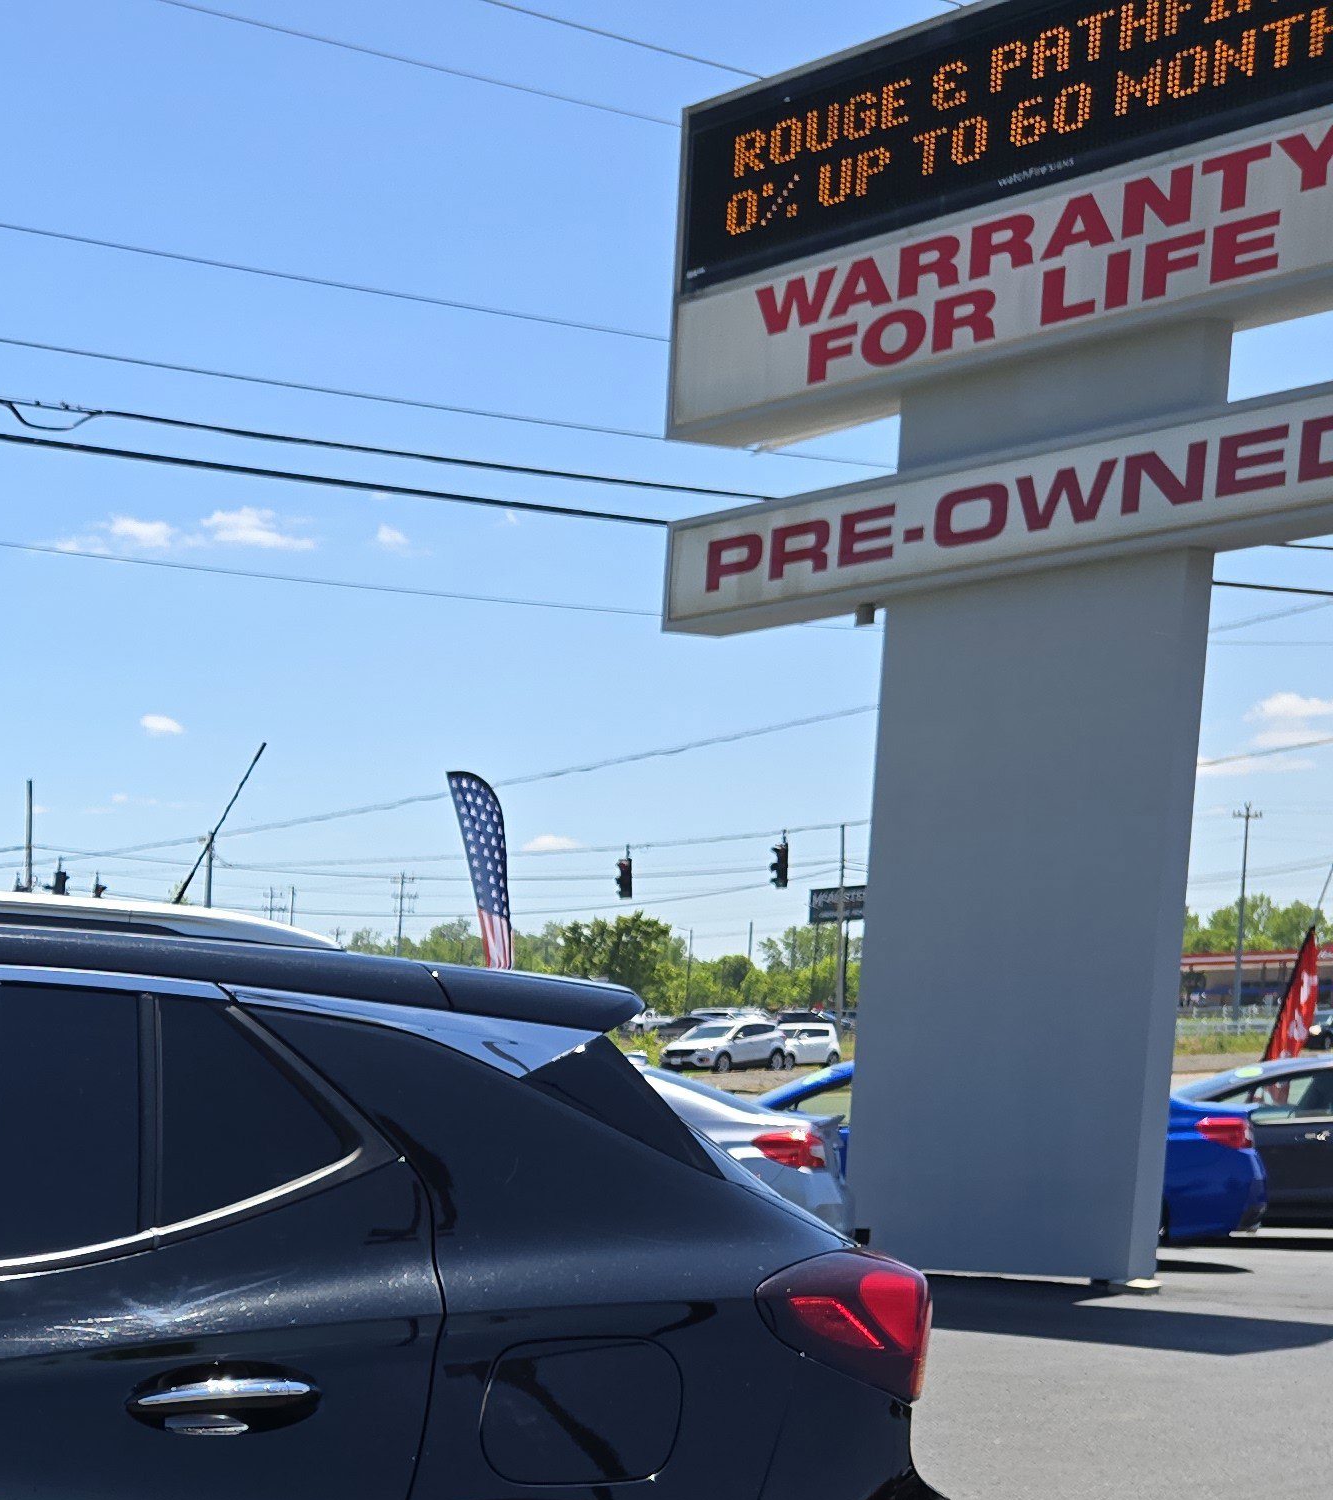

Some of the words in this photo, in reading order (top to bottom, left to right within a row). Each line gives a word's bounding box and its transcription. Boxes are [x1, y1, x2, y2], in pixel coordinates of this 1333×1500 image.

[725, 173, 800, 236] 0%
[818, 146, 891, 207] UP
[912, 115, 988, 176] TO
[1009, 82, 1092, 147] 60
[733, 78, 911, 179] ROUGE
[989, 0, 1278, 94] PATHF
[755, 125, 1333, 335] WARRANTY
[806, 288, 996, 385] FOR
[1040, 209, 1281, 326] LIFE
